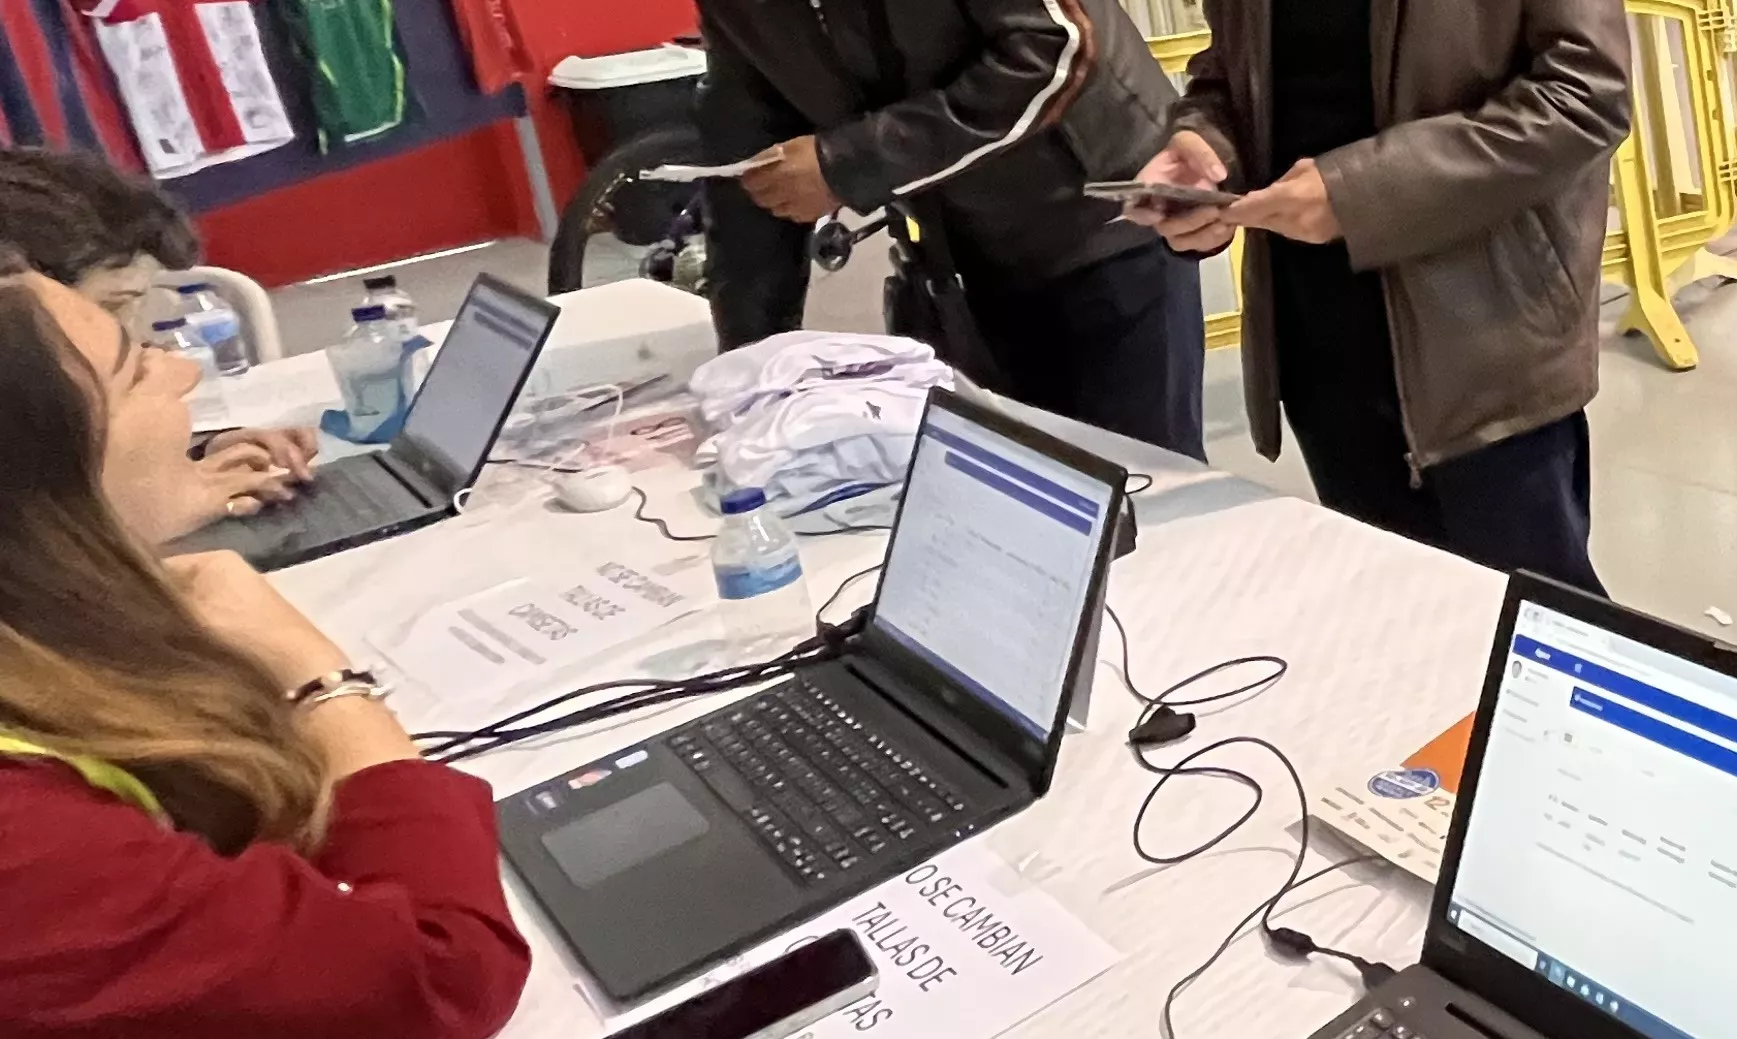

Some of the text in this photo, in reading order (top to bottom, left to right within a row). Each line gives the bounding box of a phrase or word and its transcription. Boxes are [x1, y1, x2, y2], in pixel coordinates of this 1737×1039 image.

[851, 901, 958, 992] TALLAS DE
[905, 864, 1044, 976] O SE CAMBIAN
